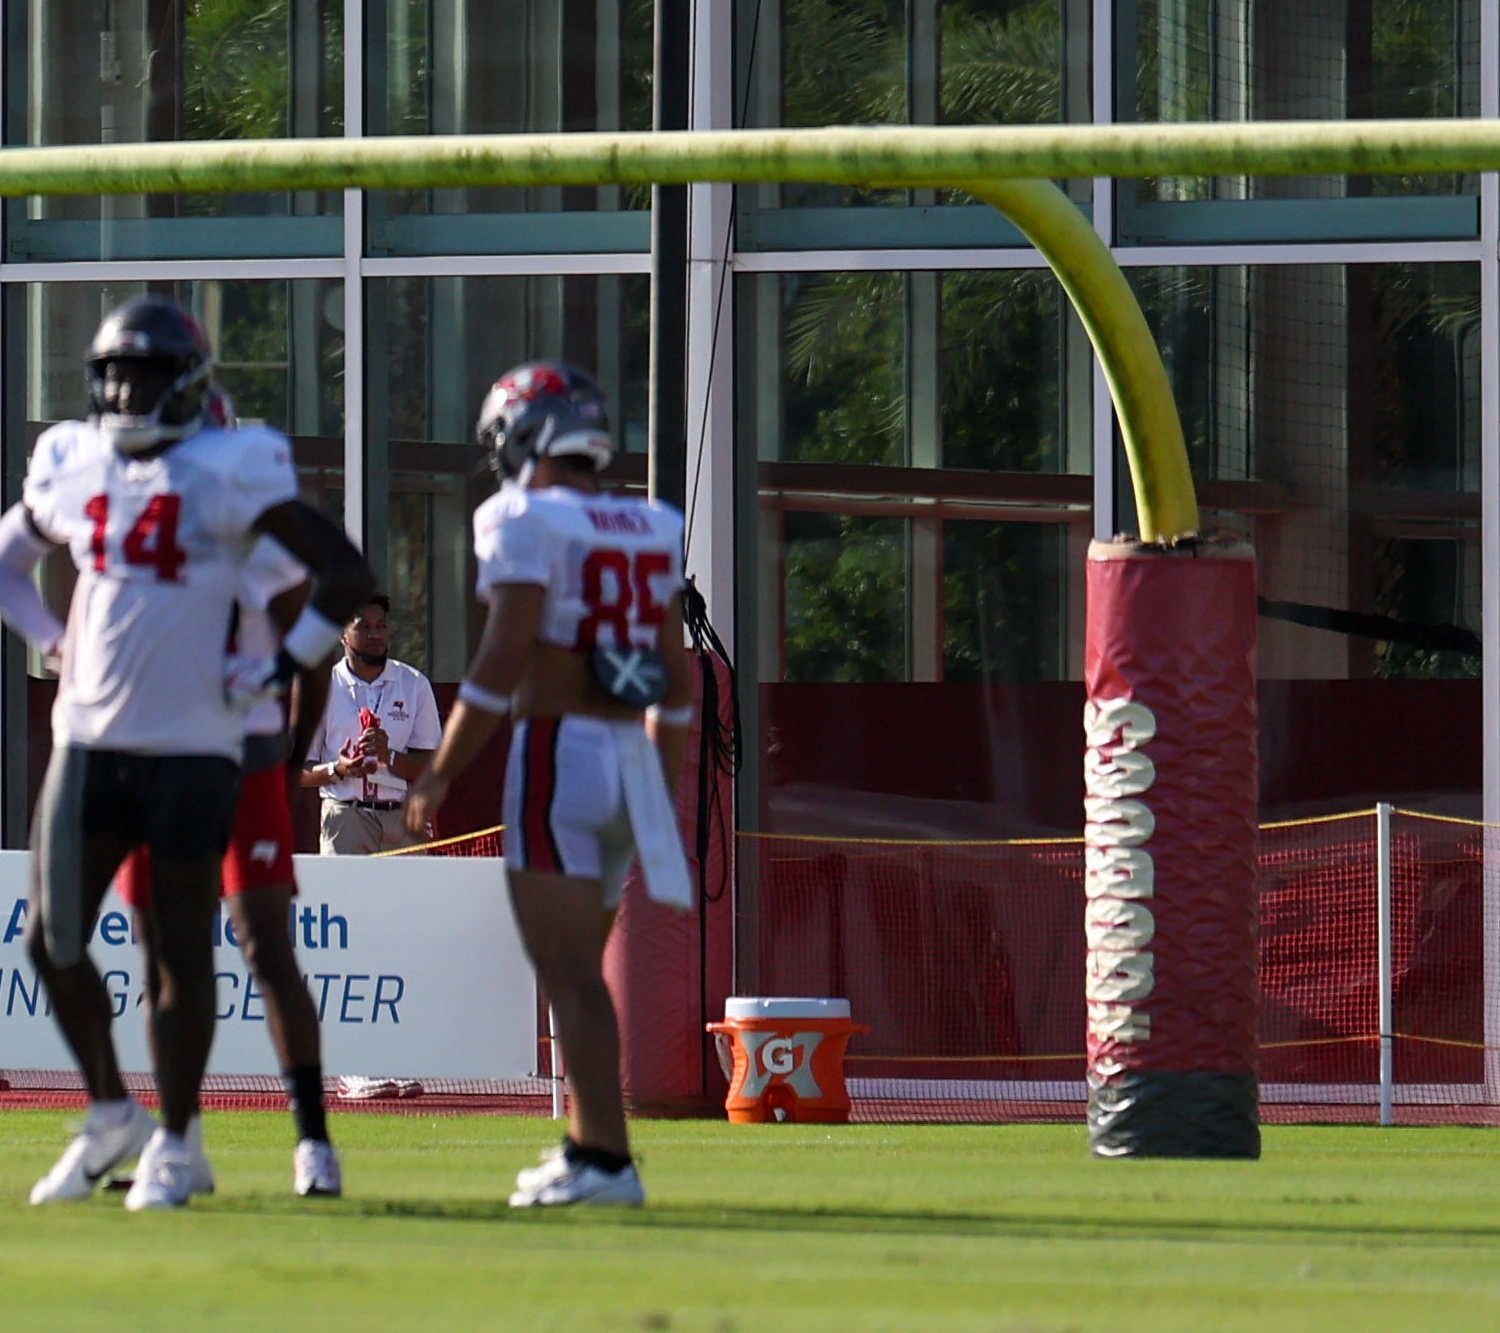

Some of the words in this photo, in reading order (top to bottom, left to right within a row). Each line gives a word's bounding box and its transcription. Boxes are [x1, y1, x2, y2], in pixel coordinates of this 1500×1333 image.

[84, 493, 186, 584] 14
[575, 549, 671, 651] 85
[214, 972, 405, 1024] CETER
[762, 1037, 794, 1075] G
